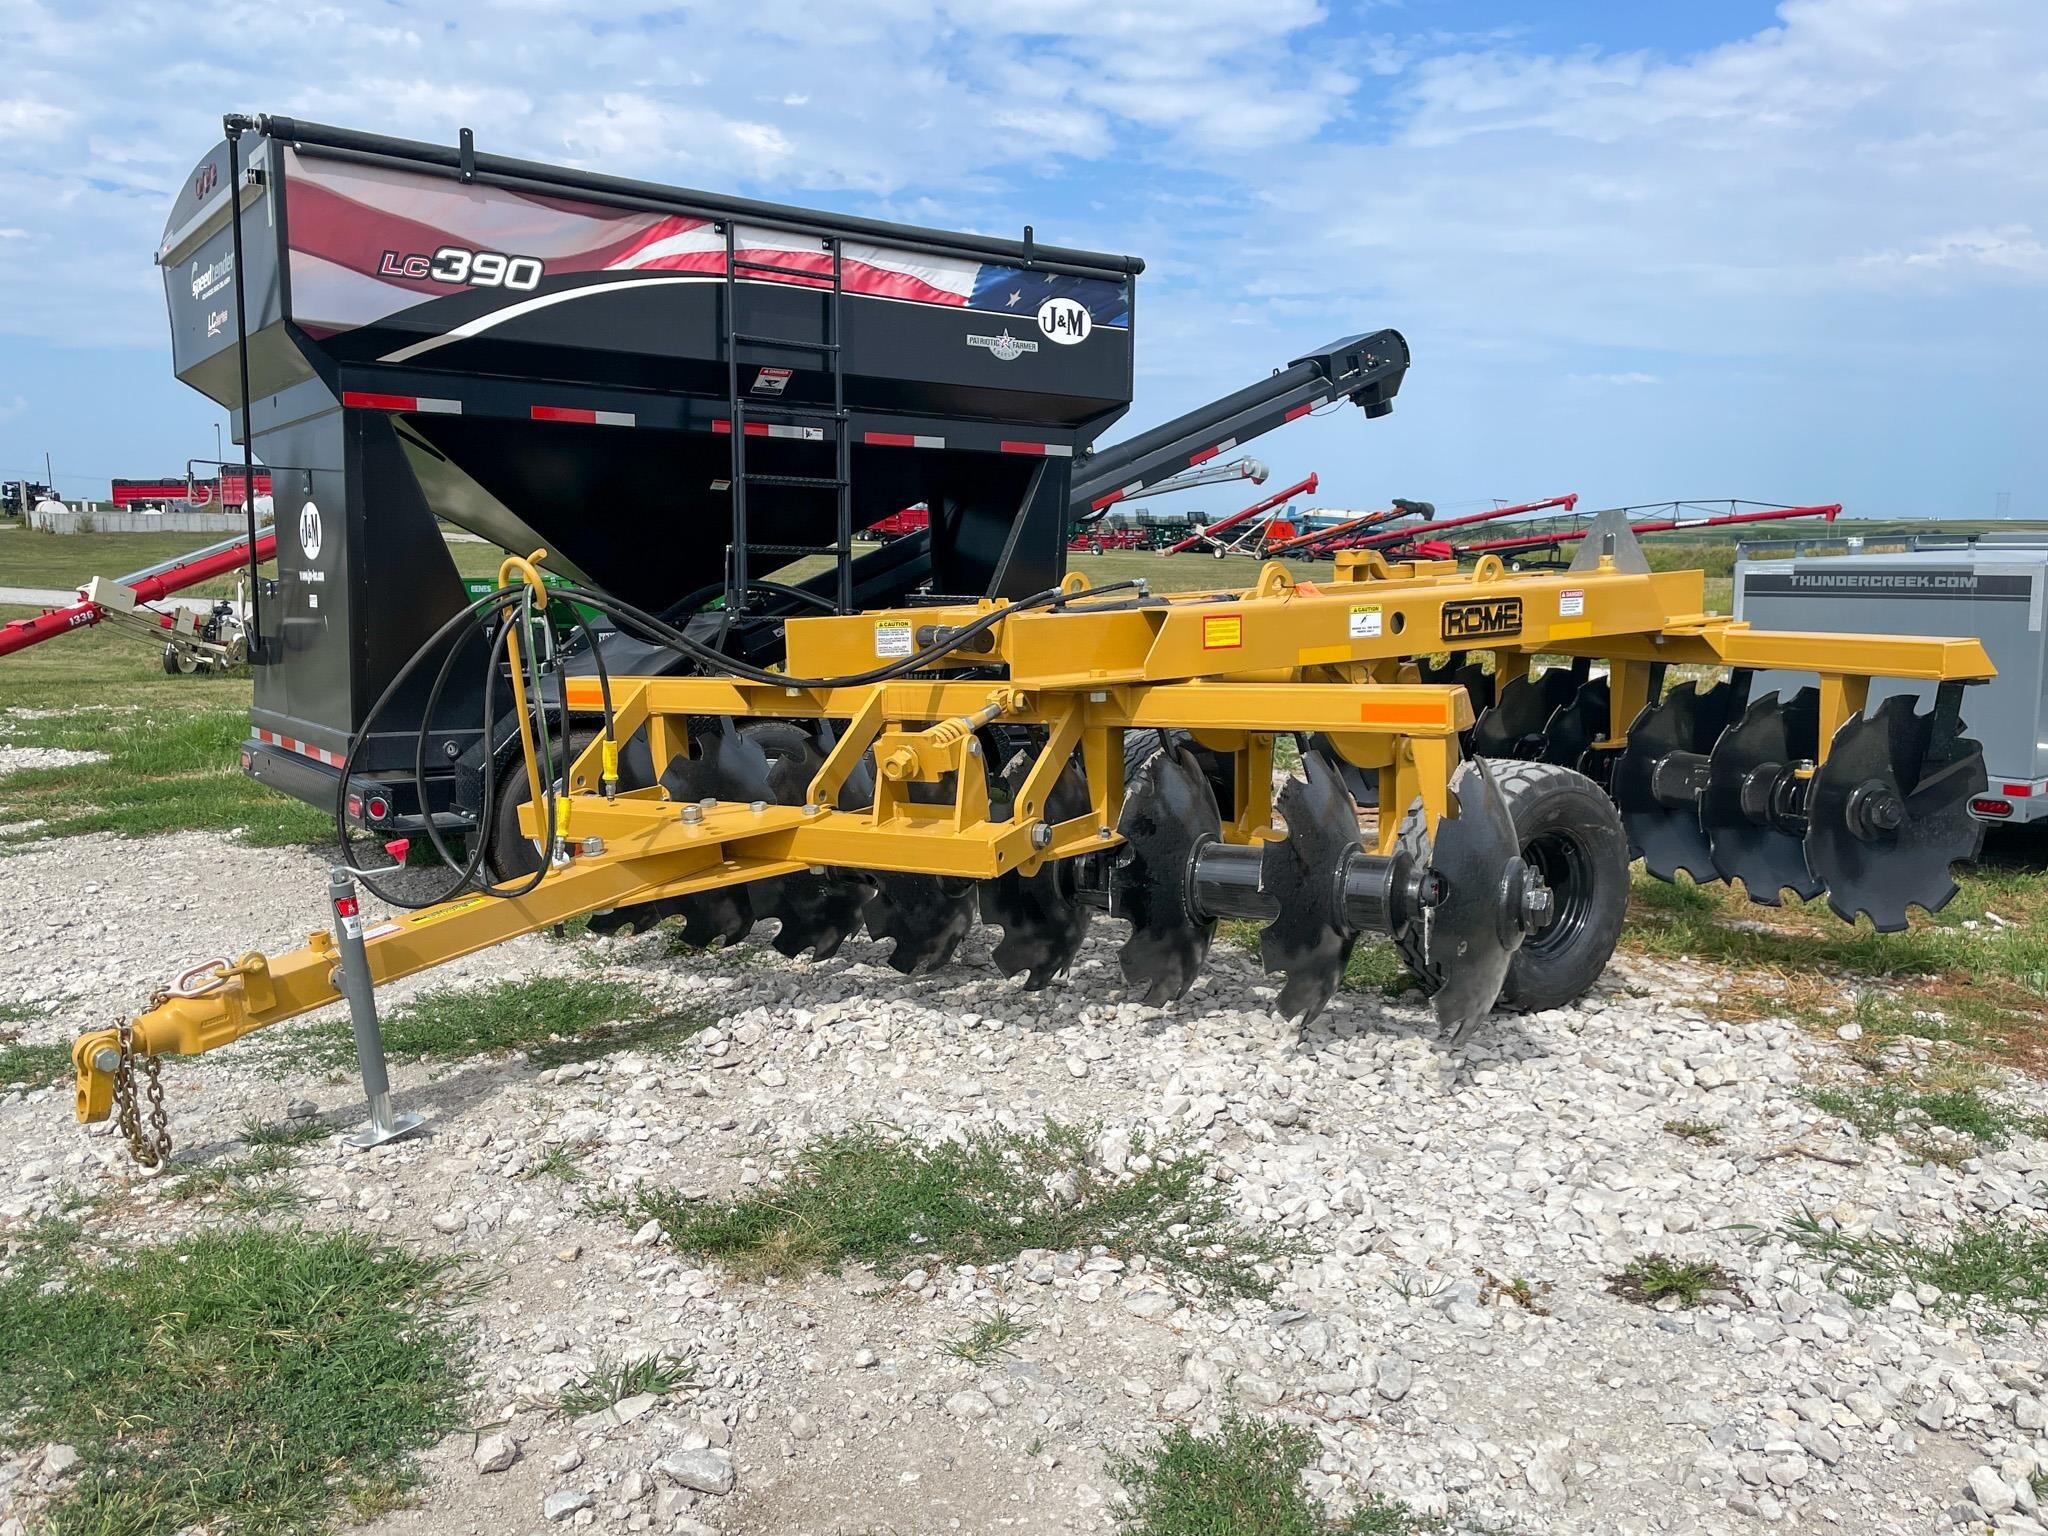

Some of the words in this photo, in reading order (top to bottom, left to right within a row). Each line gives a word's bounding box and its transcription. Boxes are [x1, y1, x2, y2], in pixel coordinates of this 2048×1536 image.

[1042, 306, 1085, 337] J&M
[969, 336, 1000, 347] PATRIOTIC
[1012, 341, 1037, 351] FARMER
[302, 513, 319, 548] J&M
[1790, 575, 1978, 588] THUNDERCREEK.COM
[69, 610, 94, 626] 1336
[1444, 603, 1522, 635] ROME
[883, 622, 909, 632] CAUTION
